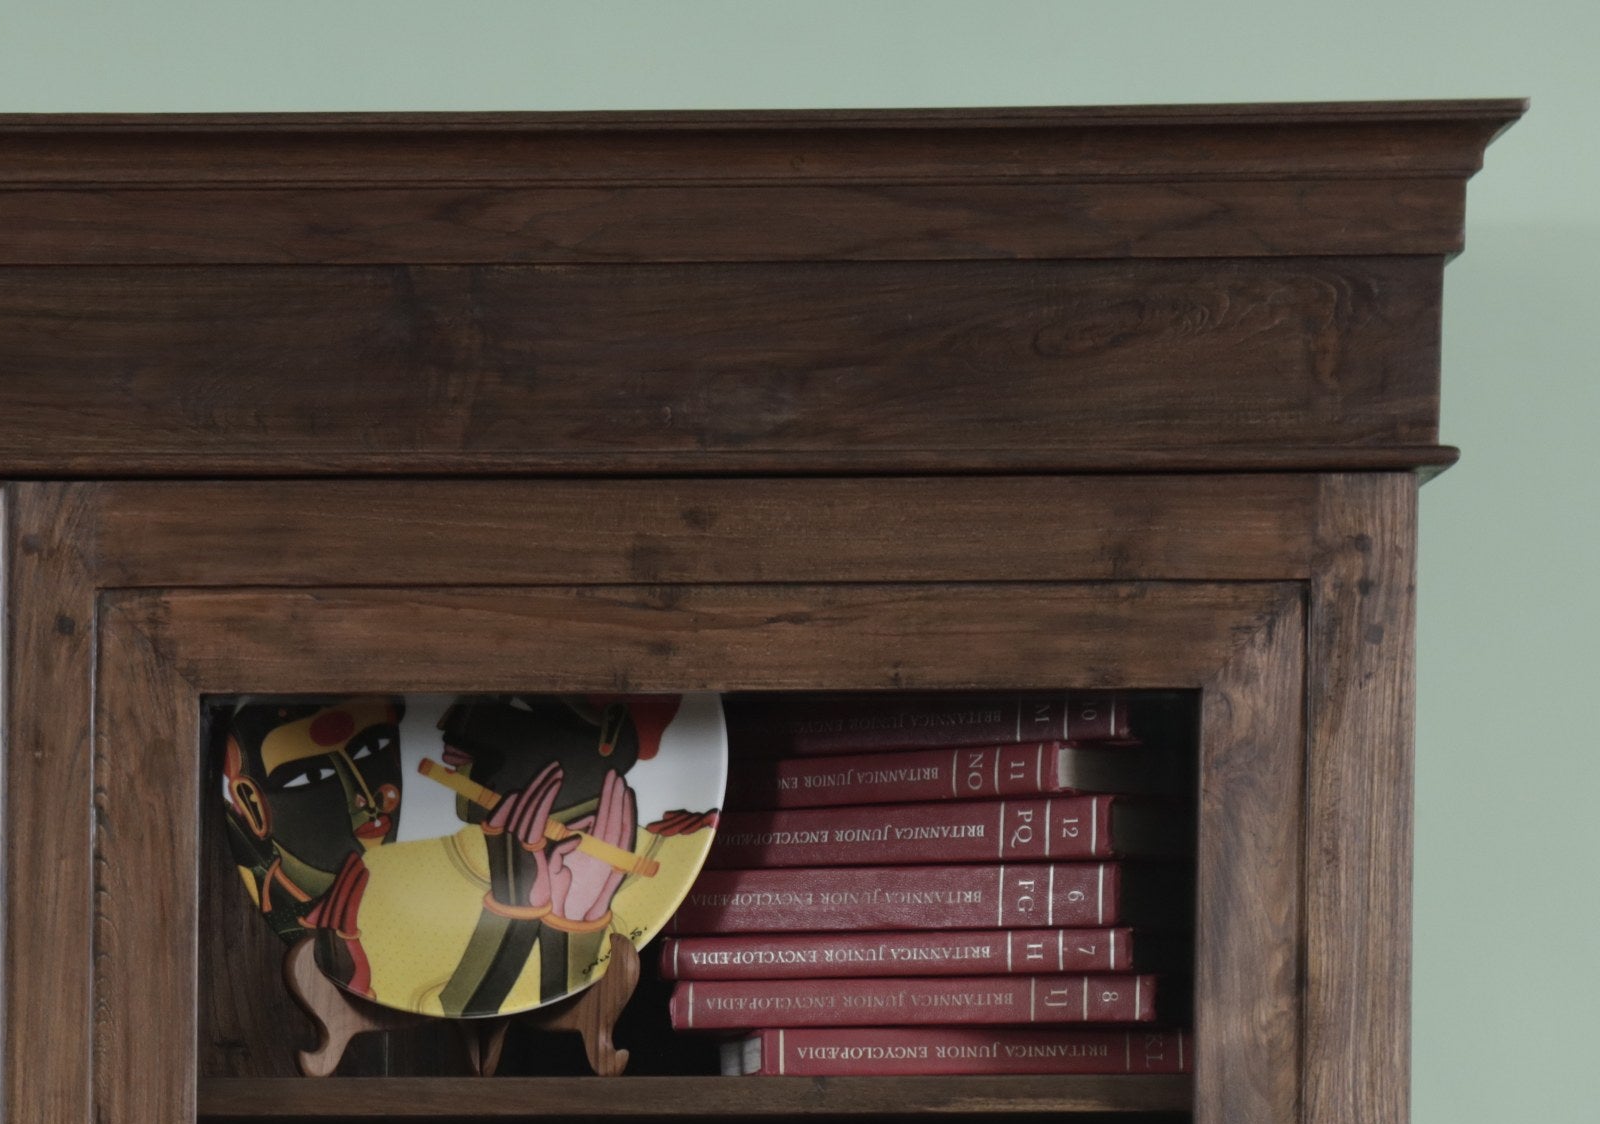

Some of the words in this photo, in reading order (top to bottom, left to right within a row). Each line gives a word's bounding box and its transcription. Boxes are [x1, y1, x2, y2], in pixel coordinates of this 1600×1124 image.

[804, 769, 854, 788] JUNIOR
[856, 767, 939, 785] BRITANNICA
[967, 753, 984, 791] NO
[1010, 760, 1025, 780] 11
[835, 825, 893, 842] JUNIOR
[895, 824, 985, 841] BRITANNICA
[1011, 809, 1033, 849] PQ
[1062, 817, 1079, 839] 12
[820, 888, 880, 906] JUNIOR
[880, 889, 983, 906] BRITANNICA
[1017, 880, 1035, 912] FG
[825, 944, 886, 962] JUNIOR
[890, 945, 991, 961] BRITANNICA
[1026, 943, 1043, 960] H
[1078, 945, 1096, 956] 7
[843, 990, 907, 1008] JUNIOR
[911, 992, 1014, 1007] BRITANNICA
[1101, 990, 1119, 1003] 8
[936, 1040, 1000, 1060] JUNIOR
[1004, 1043, 1108, 1059] BRITANNICA
